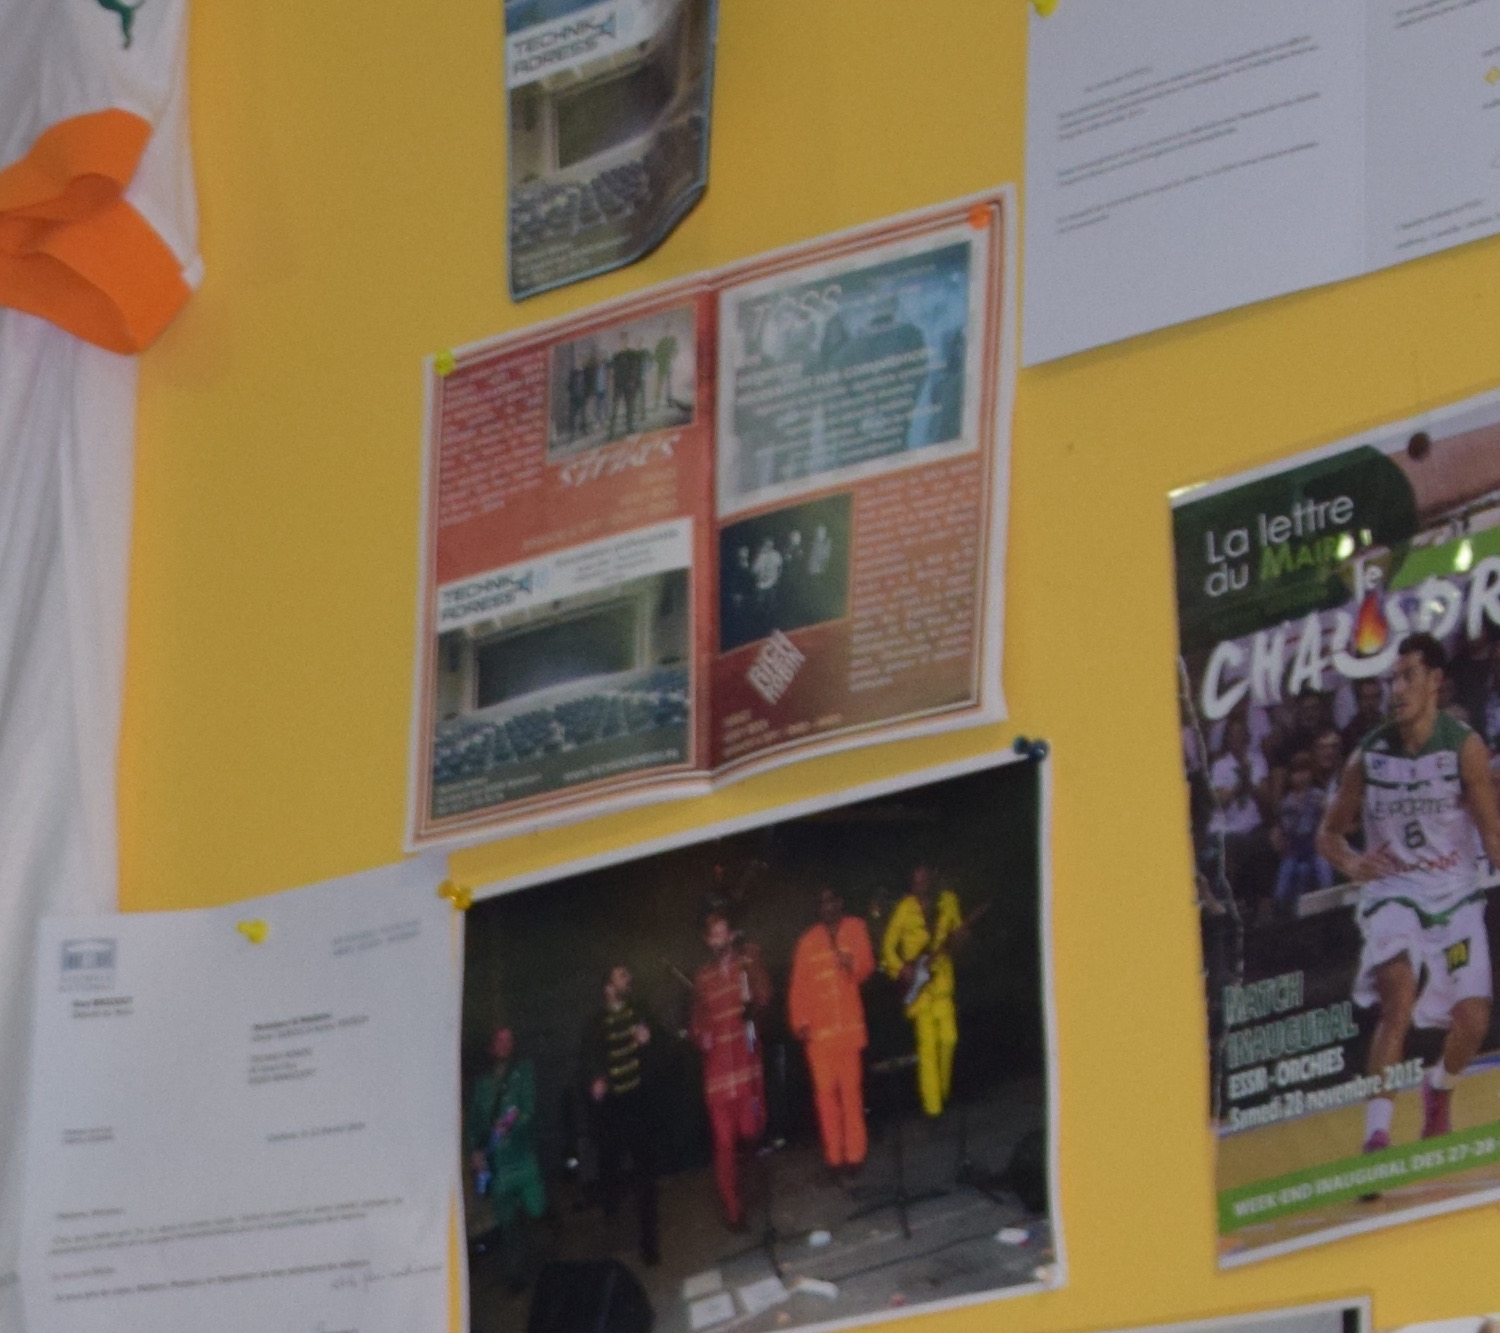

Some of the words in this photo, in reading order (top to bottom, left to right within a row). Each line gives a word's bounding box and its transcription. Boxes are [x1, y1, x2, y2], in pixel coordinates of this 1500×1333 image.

[513, 40, 600, 75] ADRESS
[514, 18, 603, 54] TECHNIK
[1205, 526, 1250, 565] La
[1258, 495, 1355, 548] lettre
[442, 573, 516, 604] TECHNIK
[1205, 561, 1250, 598] du
[1223, 971, 1304, 1028] MATCH
[1226, 1001, 1360, 1070] INAUGURAL
[1276, 1047, 1346, 1089] ORCHIES
[1229, 1096, 1283, 1133] Samedi
[1303, 1069, 1382, 1113] novembre
[1384, 1057, 1425, 1093] 2015
[1234, 1173, 1313, 1218] WEEK-END
[1314, 1156, 1407, 1197] INAUGURAL
[1412, 1149, 1445, 1173] DES
